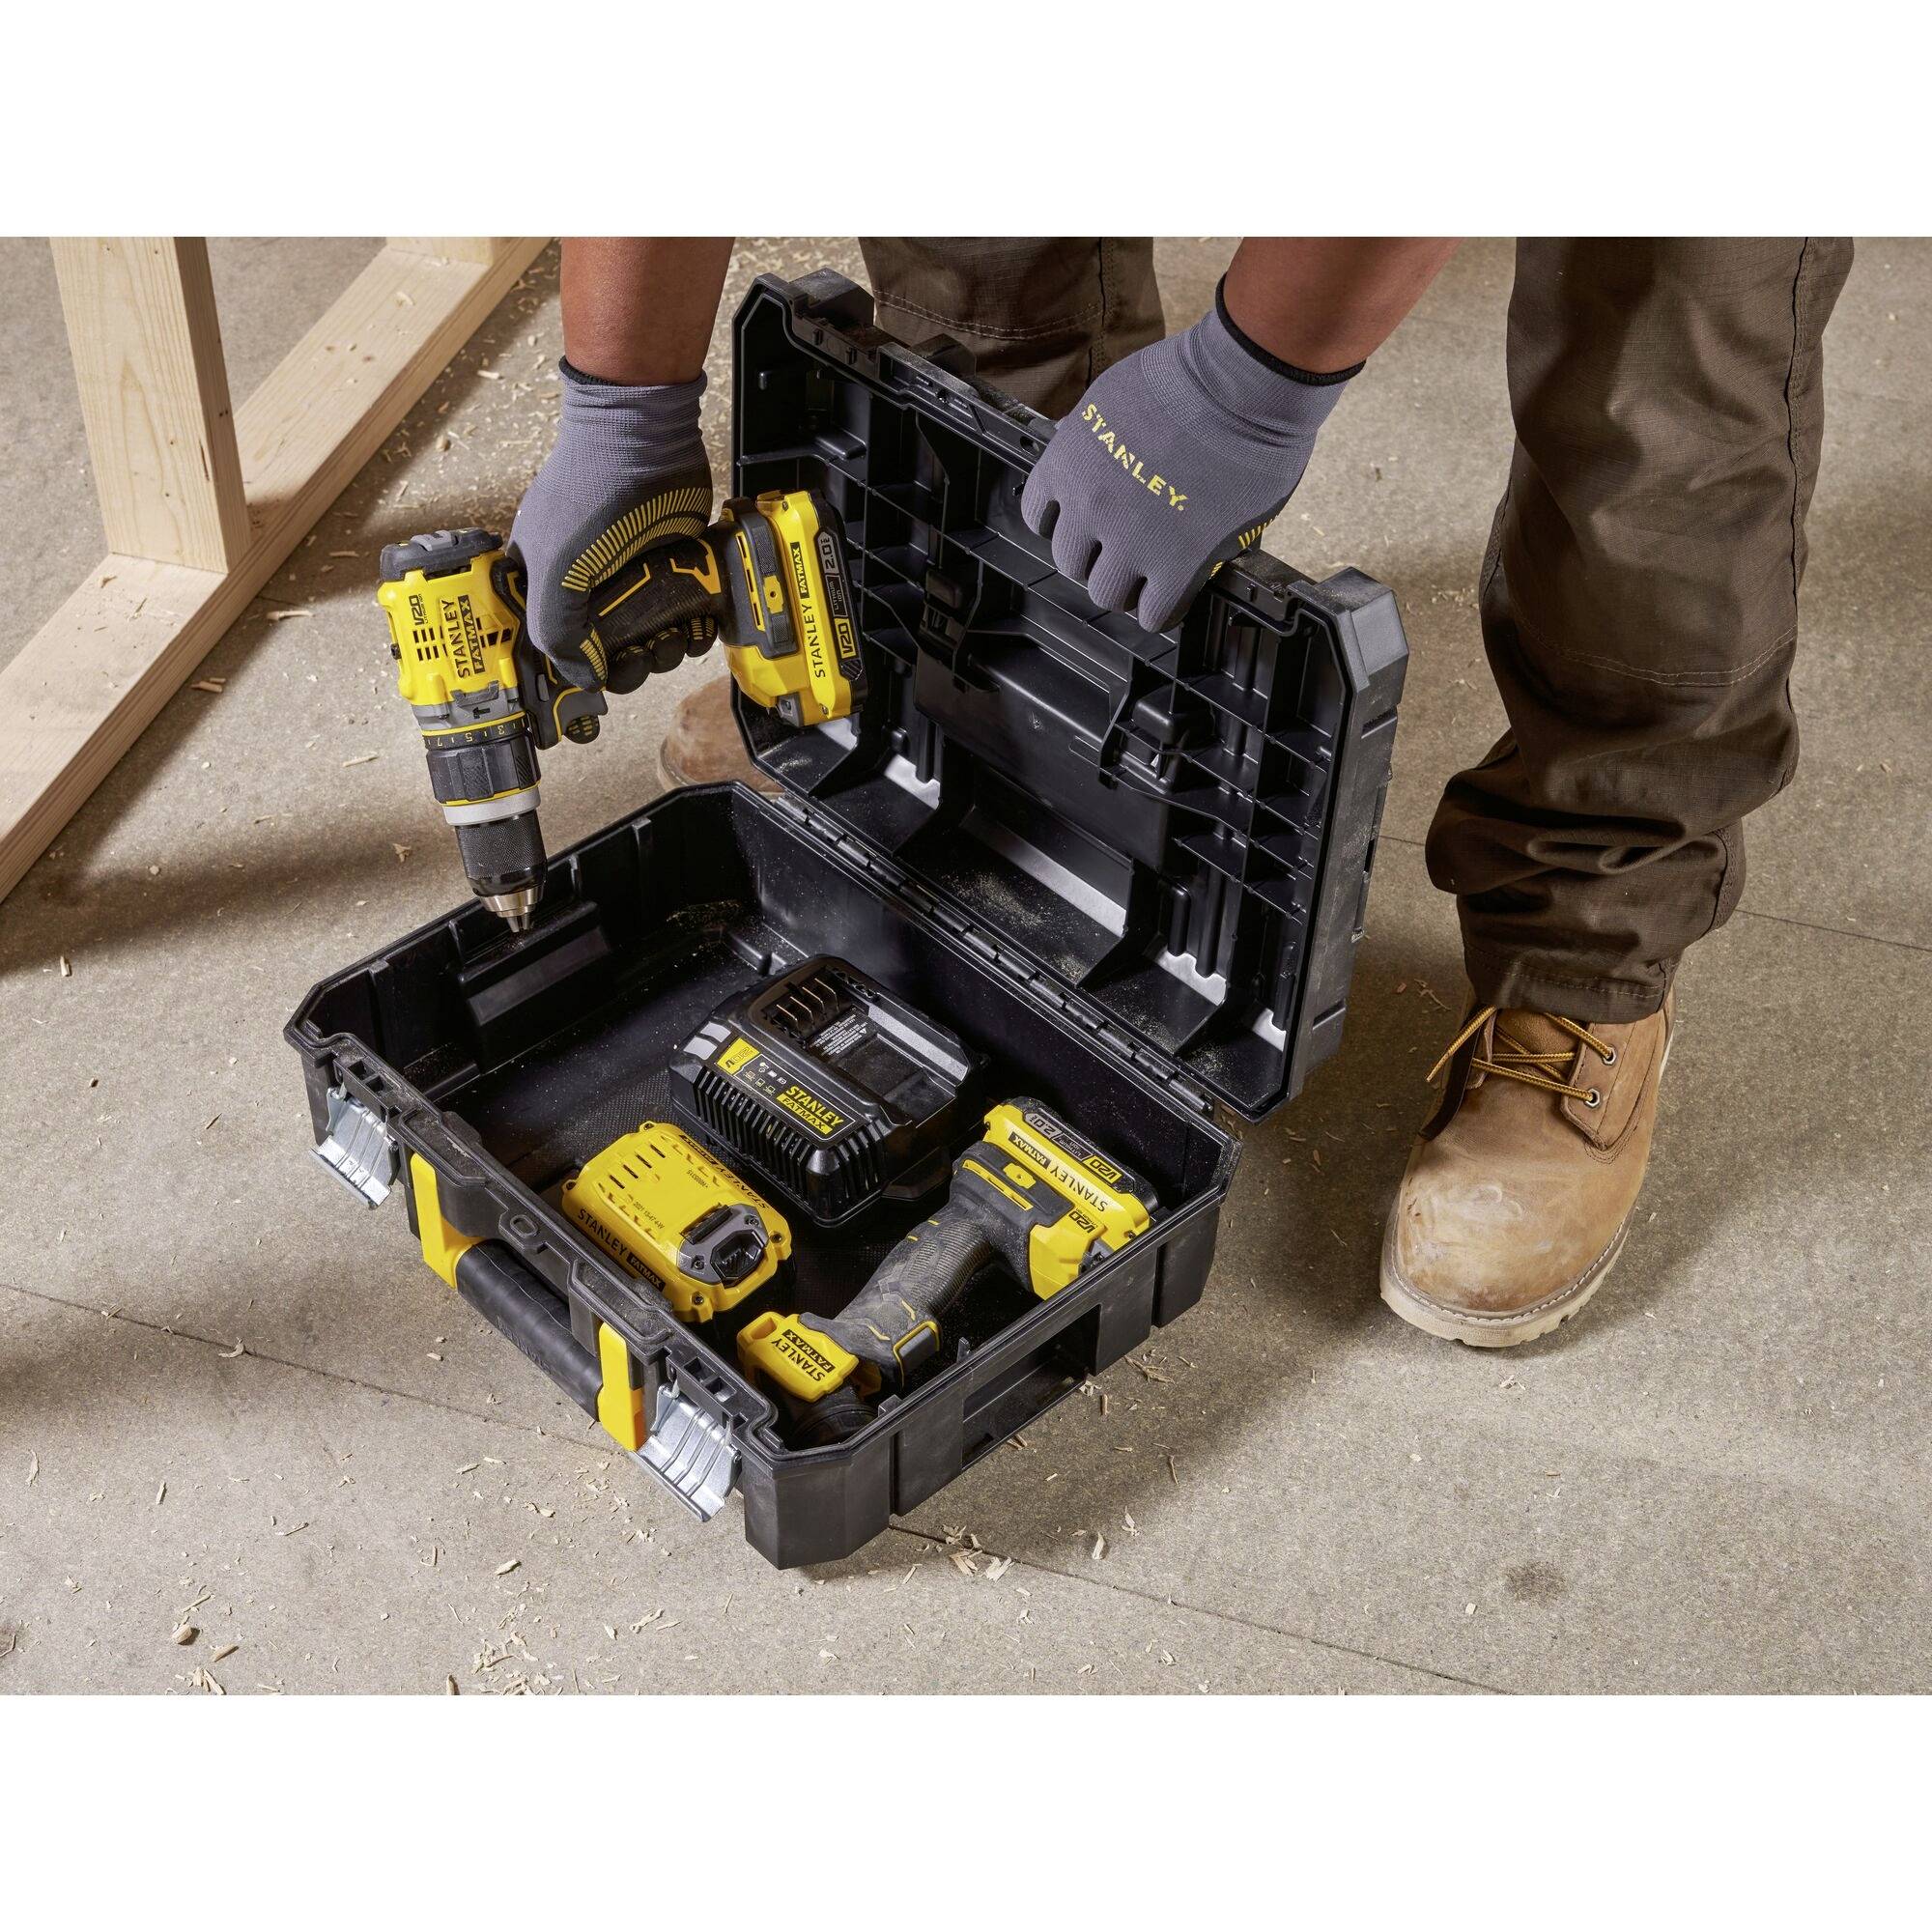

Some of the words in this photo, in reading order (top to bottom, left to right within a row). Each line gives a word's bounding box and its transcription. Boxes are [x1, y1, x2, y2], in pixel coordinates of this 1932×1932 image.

[1081, 403, 1189, 508] STANLEY
[791, 545, 810, 597] FATMAX
[822, 544, 836, 569] 2.0
[408, 594, 425, 626] V20
[440, 598, 470, 678] STANLEY
[459, 596, 485, 673] FATMAX
[801, 603, 826, 678] STANLEY
[838, 621, 854, 654] V20
[781, 1096, 825, 1131] FATMAX
[785, 1085, 844, 1127] STANLEY
[1033, 1118, 1056, 1135] 2.0
[1012, 1135, 1046, 1166] FATMAX
[1089, 1158, 1118, 1179] V20
[716, 1166, 770, 1208] STANLEY
[1050, 1166, 1109, 1212] STANLEY
[1068, 1210, 1096, 1234] V20
[577, 1208, 629, 1257] STANLEY
[630, 1257, 663, 1289] FATMAX
[771, 1338, 826, 1381] STANLEY
[785, 1331, 833, 1371] FATMAX
